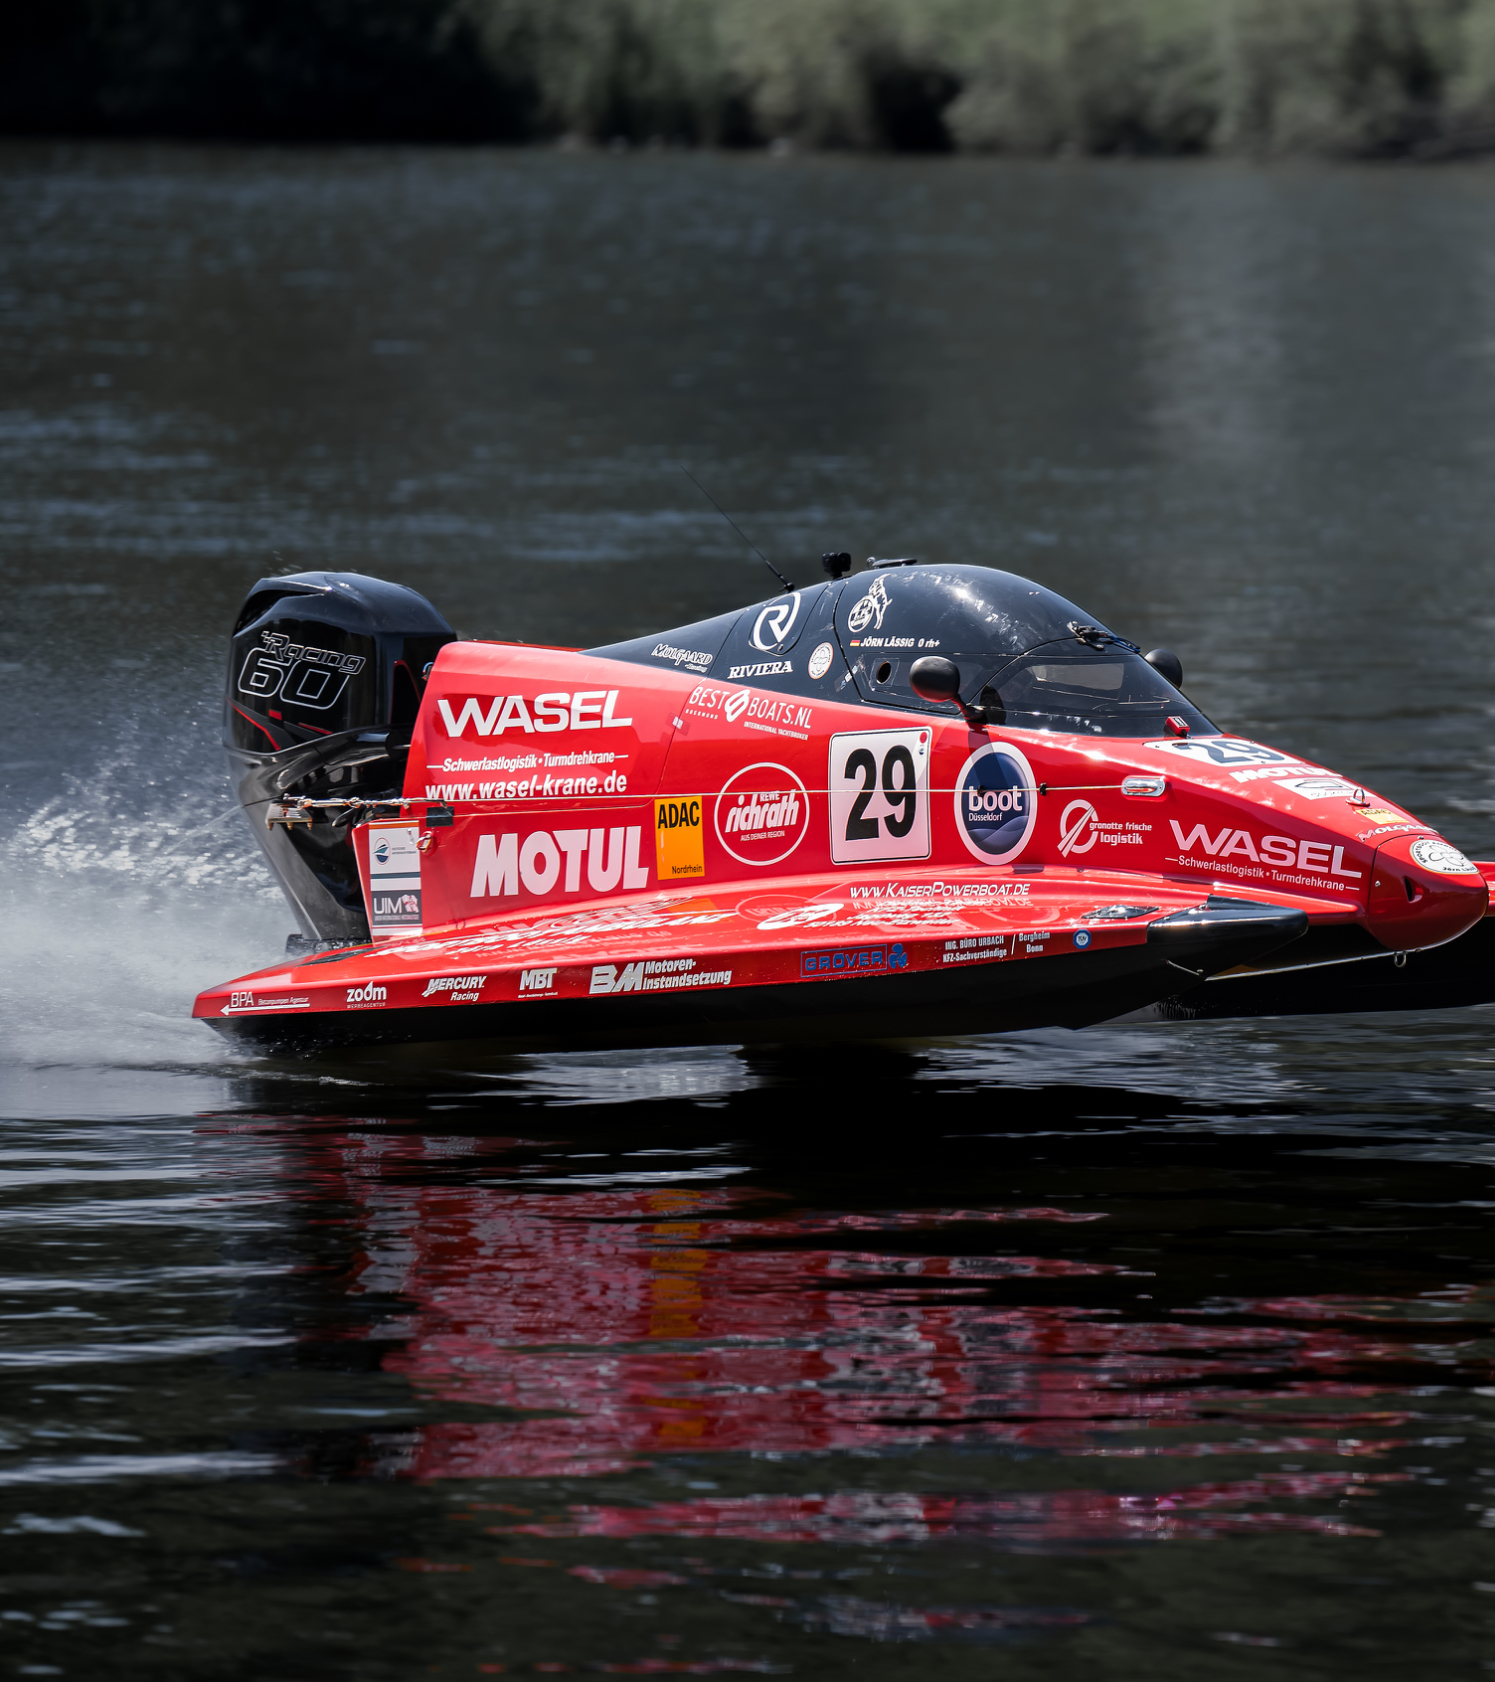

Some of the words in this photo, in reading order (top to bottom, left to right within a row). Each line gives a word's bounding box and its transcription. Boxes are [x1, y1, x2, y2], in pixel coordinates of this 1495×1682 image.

[261, 631, 366, 674] Racing
[860, 635, 883, 647] JÖRN
[884, 635, 915, 648] LÄSSIG
[238, 647, 349, 710] 60
[727, 660, 793, 679] RIVIERA
[437, 690, 633, 737] WASEL
[689, 686, 731, 710] BEST
[747, 697, 812, 729] BOATS.NL
[442, 753, 537, 772] Schwerlastlogistik
[543, 750, 615, 767] Turmdrehkrane
[425, 770, 627, 800] www.wasel-krane.de
[1229, 766, 1343, 783] MOTUL
[844, 744, 917, 841] 29
[969, 785, 1022, 812] boot
[657, 800, 700, 829] ADAC
[724, 788, 800, 834] richrath
[969, 812, 1003, 821] Düsseldorf
[1125, 822, 1152, 831] frische
[1100, 832, 1143, 846] logistik
[1169, 819, 1362, 878] WASEL
[470, 826, 649, 898] MOTUL
[671, 863, 703, 875] Nordrhein
[1178, 855, 1264, 878] Schwerlastlogistik
[1271, 870, 1344, 891] Turmdrehkrane
[374, 897, 402, 914] UIM
[978, 935, 1004, 946] URBACH
[1019, 930, 1050, 943] Bergheim
[1026, 944, 1043, 953] Bonn
[421, 975, 487, 997] MERCURY
[519, 967, 557, 991] MBT
[589, 961, 646, 994] BM
[231, 991, 254, 1007] BPA
[346, 980, 387, 1002] zoom
[450, 990, 479, 1001] Racing
